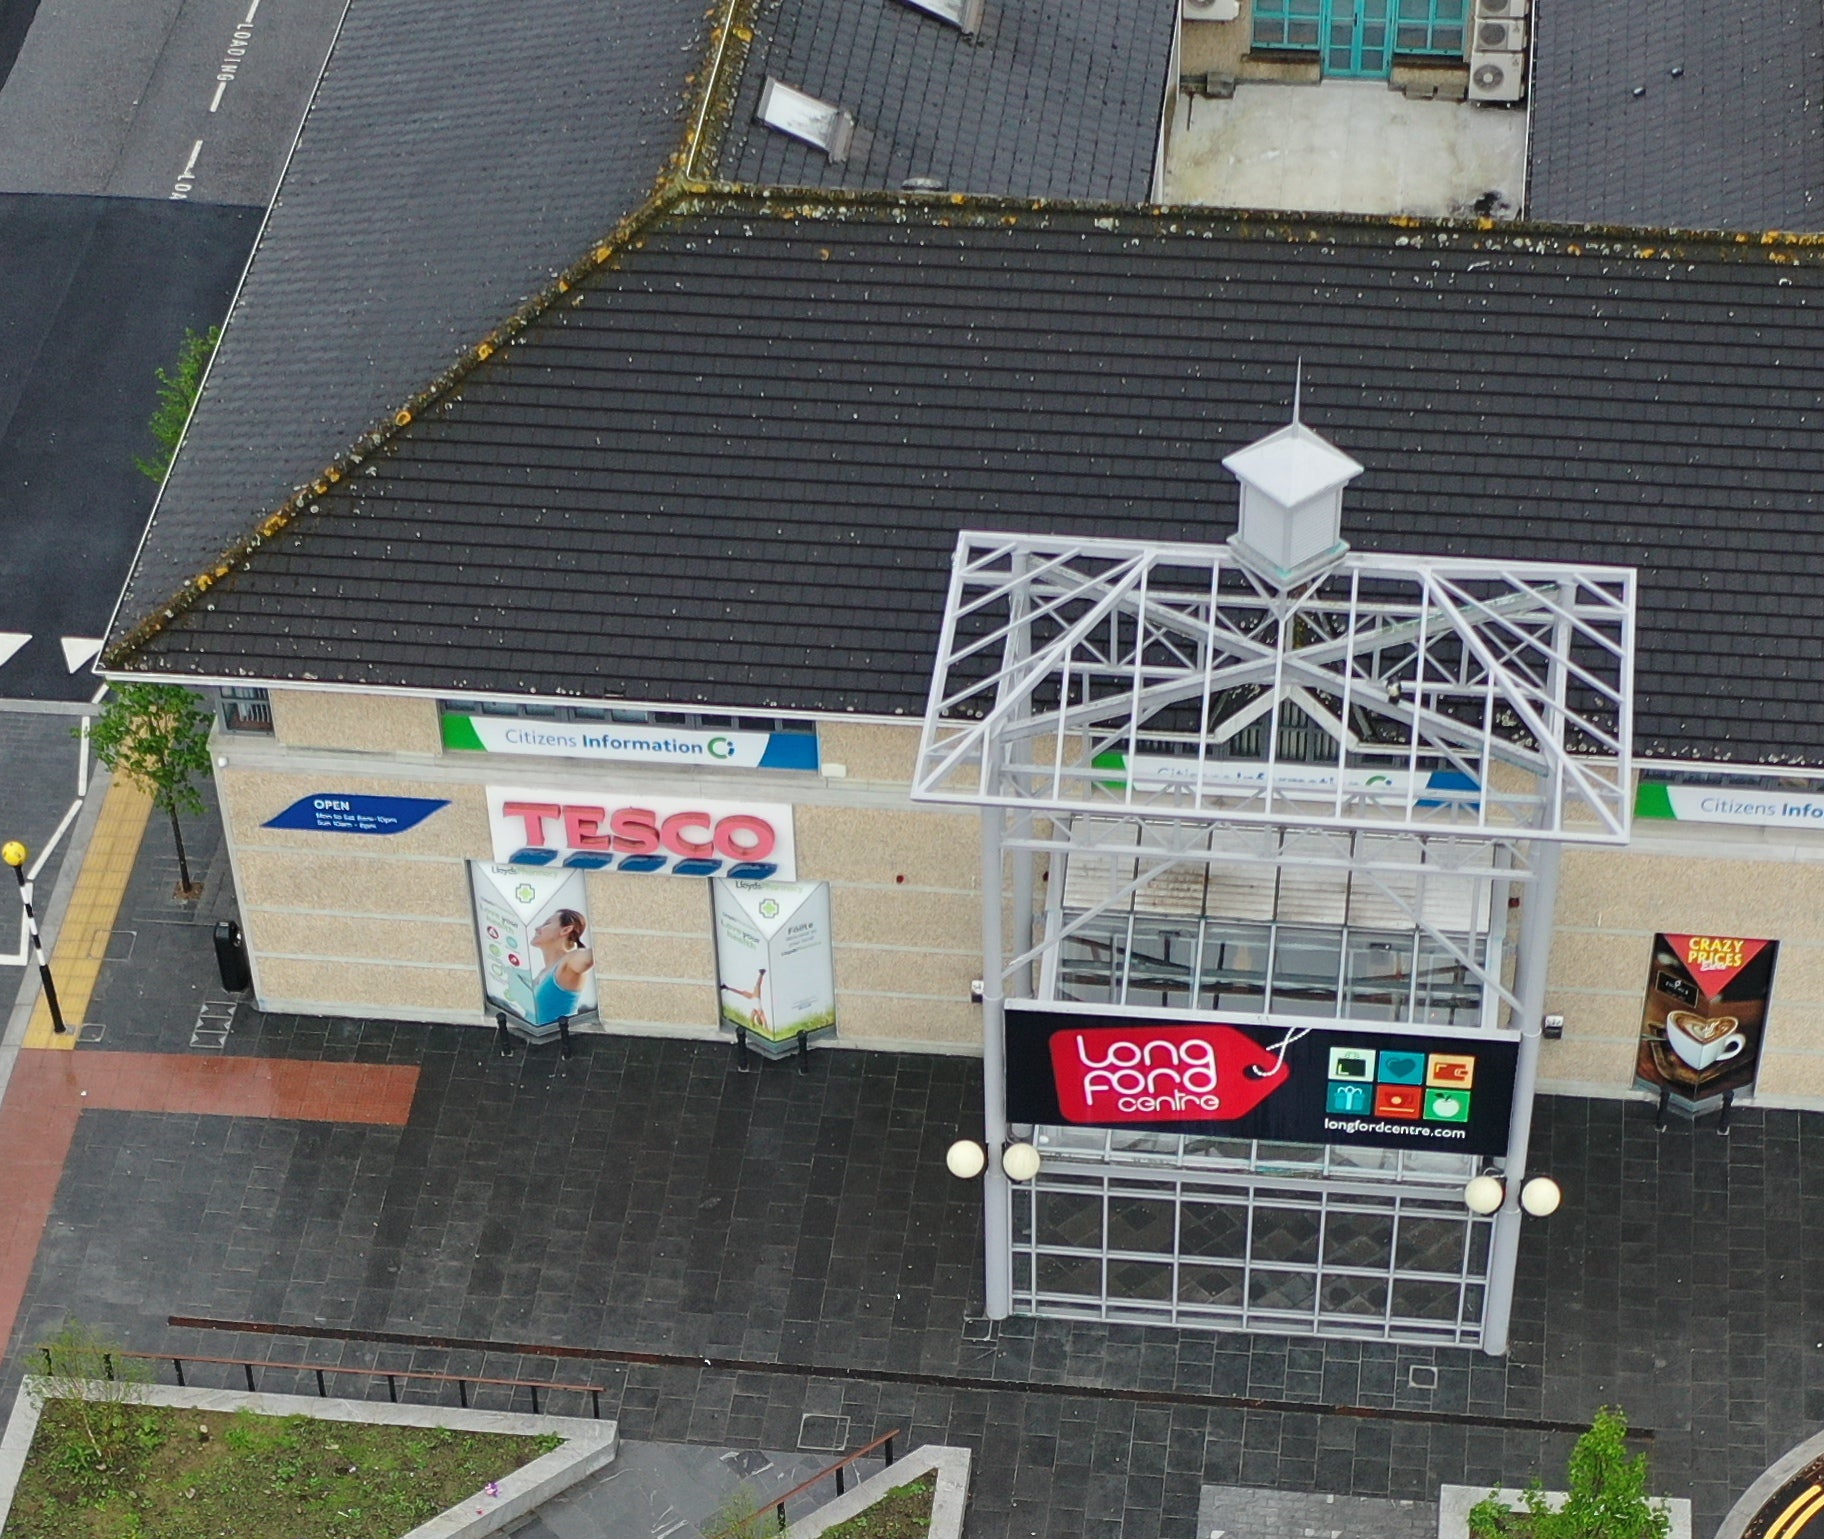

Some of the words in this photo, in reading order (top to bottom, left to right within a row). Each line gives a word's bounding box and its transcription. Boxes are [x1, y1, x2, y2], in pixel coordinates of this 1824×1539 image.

[505, 729, 576, 748] Citizens
[583, 735, 702, 754] Information
[314, 800, 350, 811] OPEN
[1701, 798, 1776, 816] Citizens
[502, 801, 776, 861] TESCO
[1689, 937, 1744, 953] CRAZY
[1688, 950, 1742, 967] PRICES
[1118, 1089, 1220, 1113] centre
[1324, 1117, 1466, 1139] longfordcentre.com
